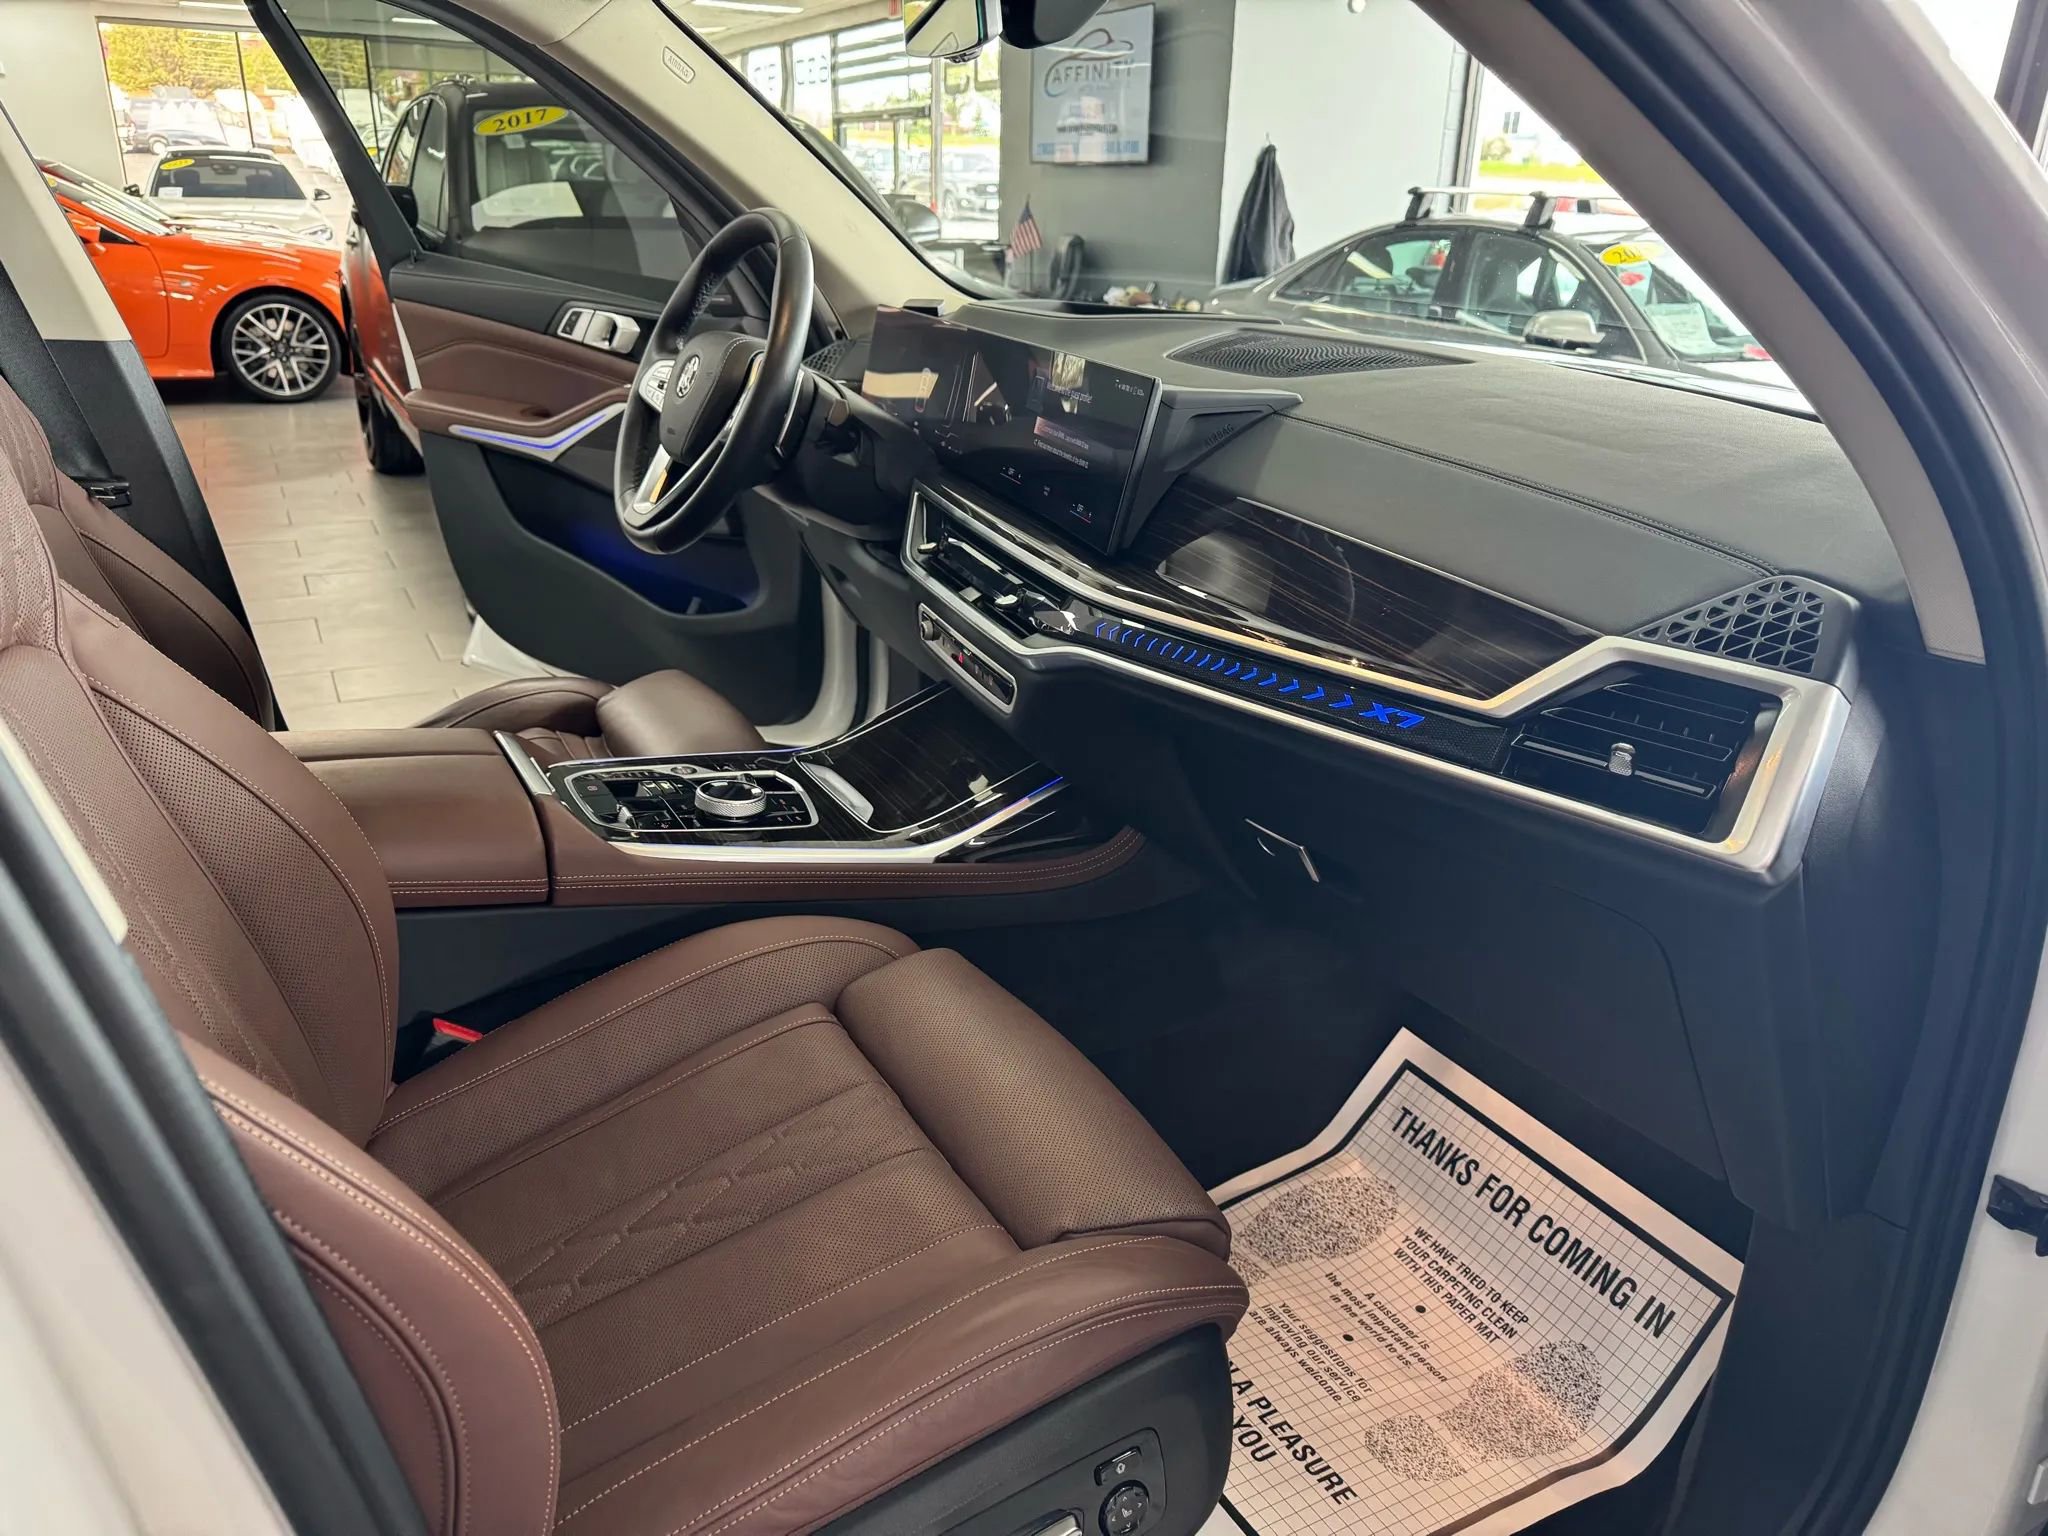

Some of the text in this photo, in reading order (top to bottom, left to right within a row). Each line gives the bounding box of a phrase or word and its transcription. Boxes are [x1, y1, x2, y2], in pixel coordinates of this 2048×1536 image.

[1051, 58, 1135, 84] AFFINITY
[493, 108, 547, 133] 2017
[1205, 423, 1234, 449] AIRBAG
[1359, 702, 1425, 729] X7
[1392, 1106, 1676, 1339] THANKS FOR COMING IN
[1393, 1247, 1501, 1344] WITH THIS PAPER MAT
[1402, 1235, 1518, 1339] YOUR CARPETING CLEAN
[1414, 1226, 1529, 1324] WE HAVE TRIED TO KEEP
[1249, 1310, 1267, 1326] are
[1265, 1326, 1299, 1358] always
[1262, 1304, 1362, 1401] improving our service
[1279, 1302, 1373, 1394] Your suggestions for
[1325, 1272, 1447, 1382] the most important person
[1329, 1293, 1341, 1303] in
[1340, 1304, 1358, 1318] the
[1357, 1319, 1388, 1343] world
[1384, 1343, 1397, 1354] to
[1364, 1292, 1430, 1351] A customer is
[1232, 1380, 1358, 1505] A PLEASURE
[1233, 1415, 1277, 1462] YOU
